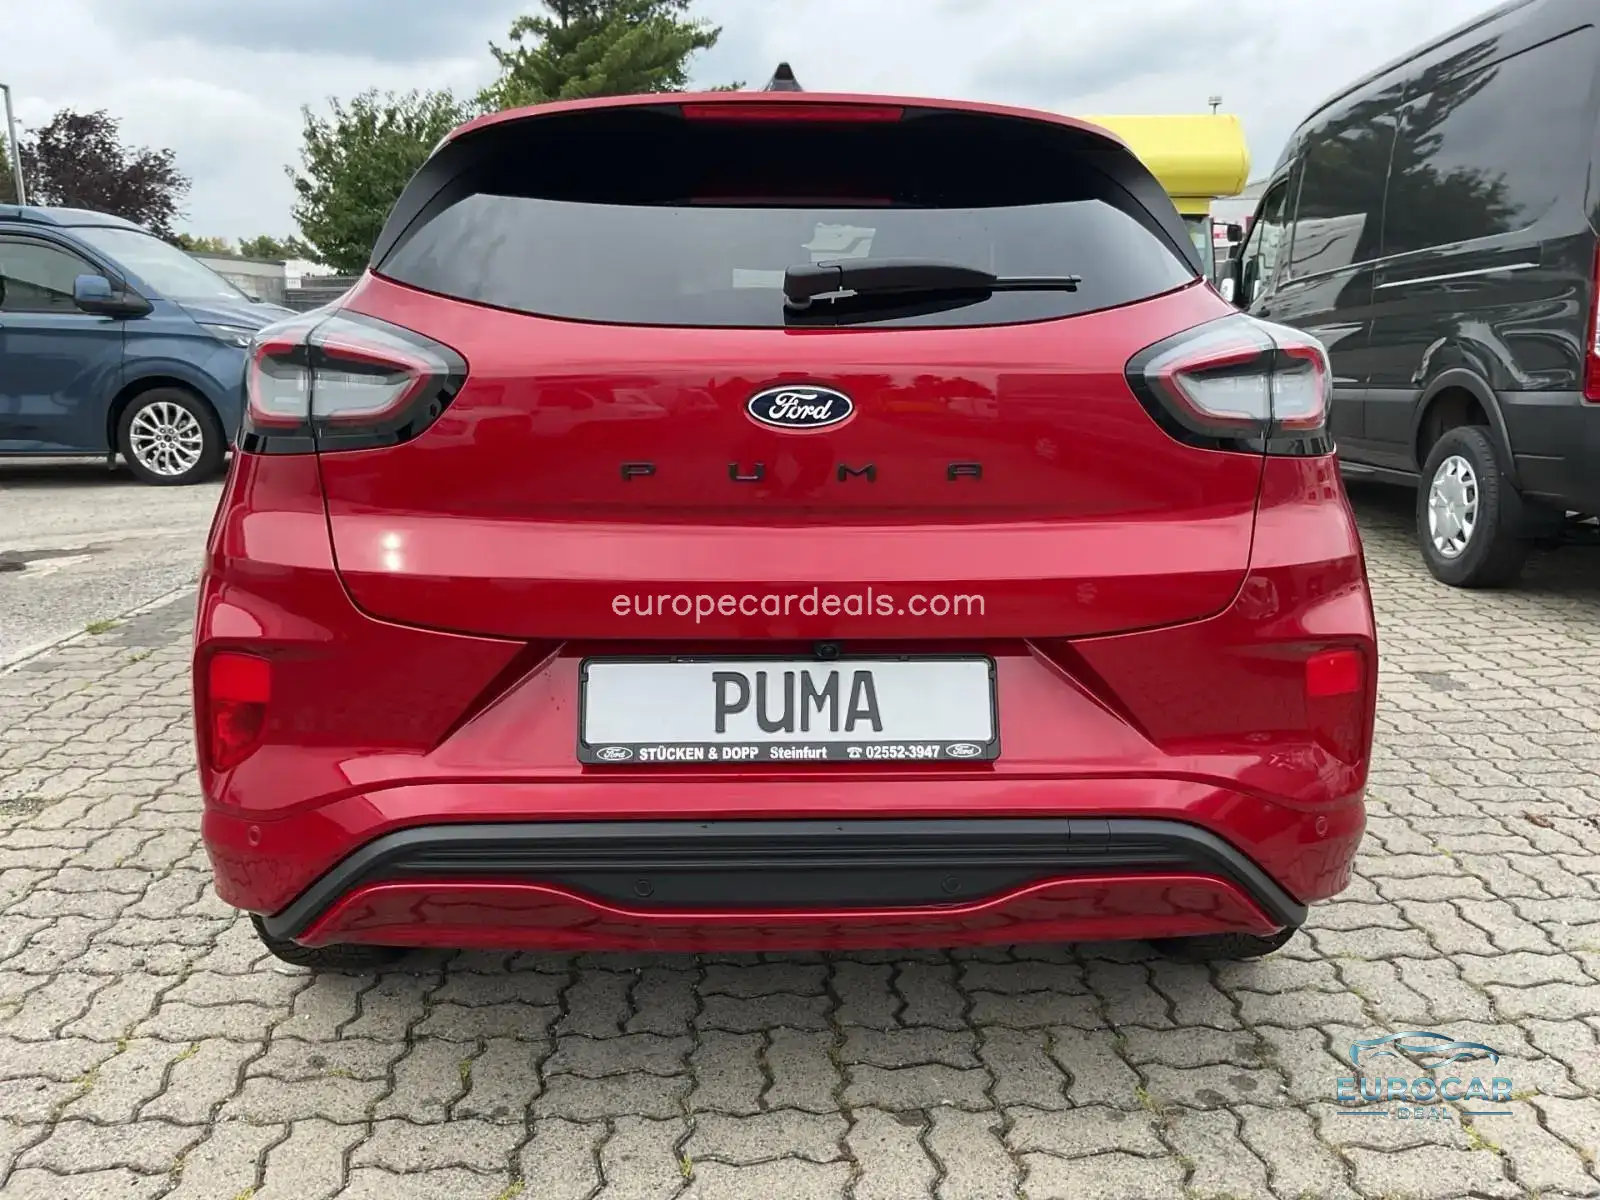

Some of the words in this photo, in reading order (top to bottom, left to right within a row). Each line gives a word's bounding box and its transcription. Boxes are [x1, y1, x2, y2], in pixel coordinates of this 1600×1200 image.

[768, 392, 833, 420] Ford
[620, 461, 984, 482] PUMA
[712, 670, 883, 733] PUMA
[639, 746, 704, 760] STÜCKEN
[708, 747, 718, 760] &
[722, 747, 759, 760] DOPP
[770, 746, 828, 759] Steinfurt
[866, 745, 940, 759] 02552-3947
